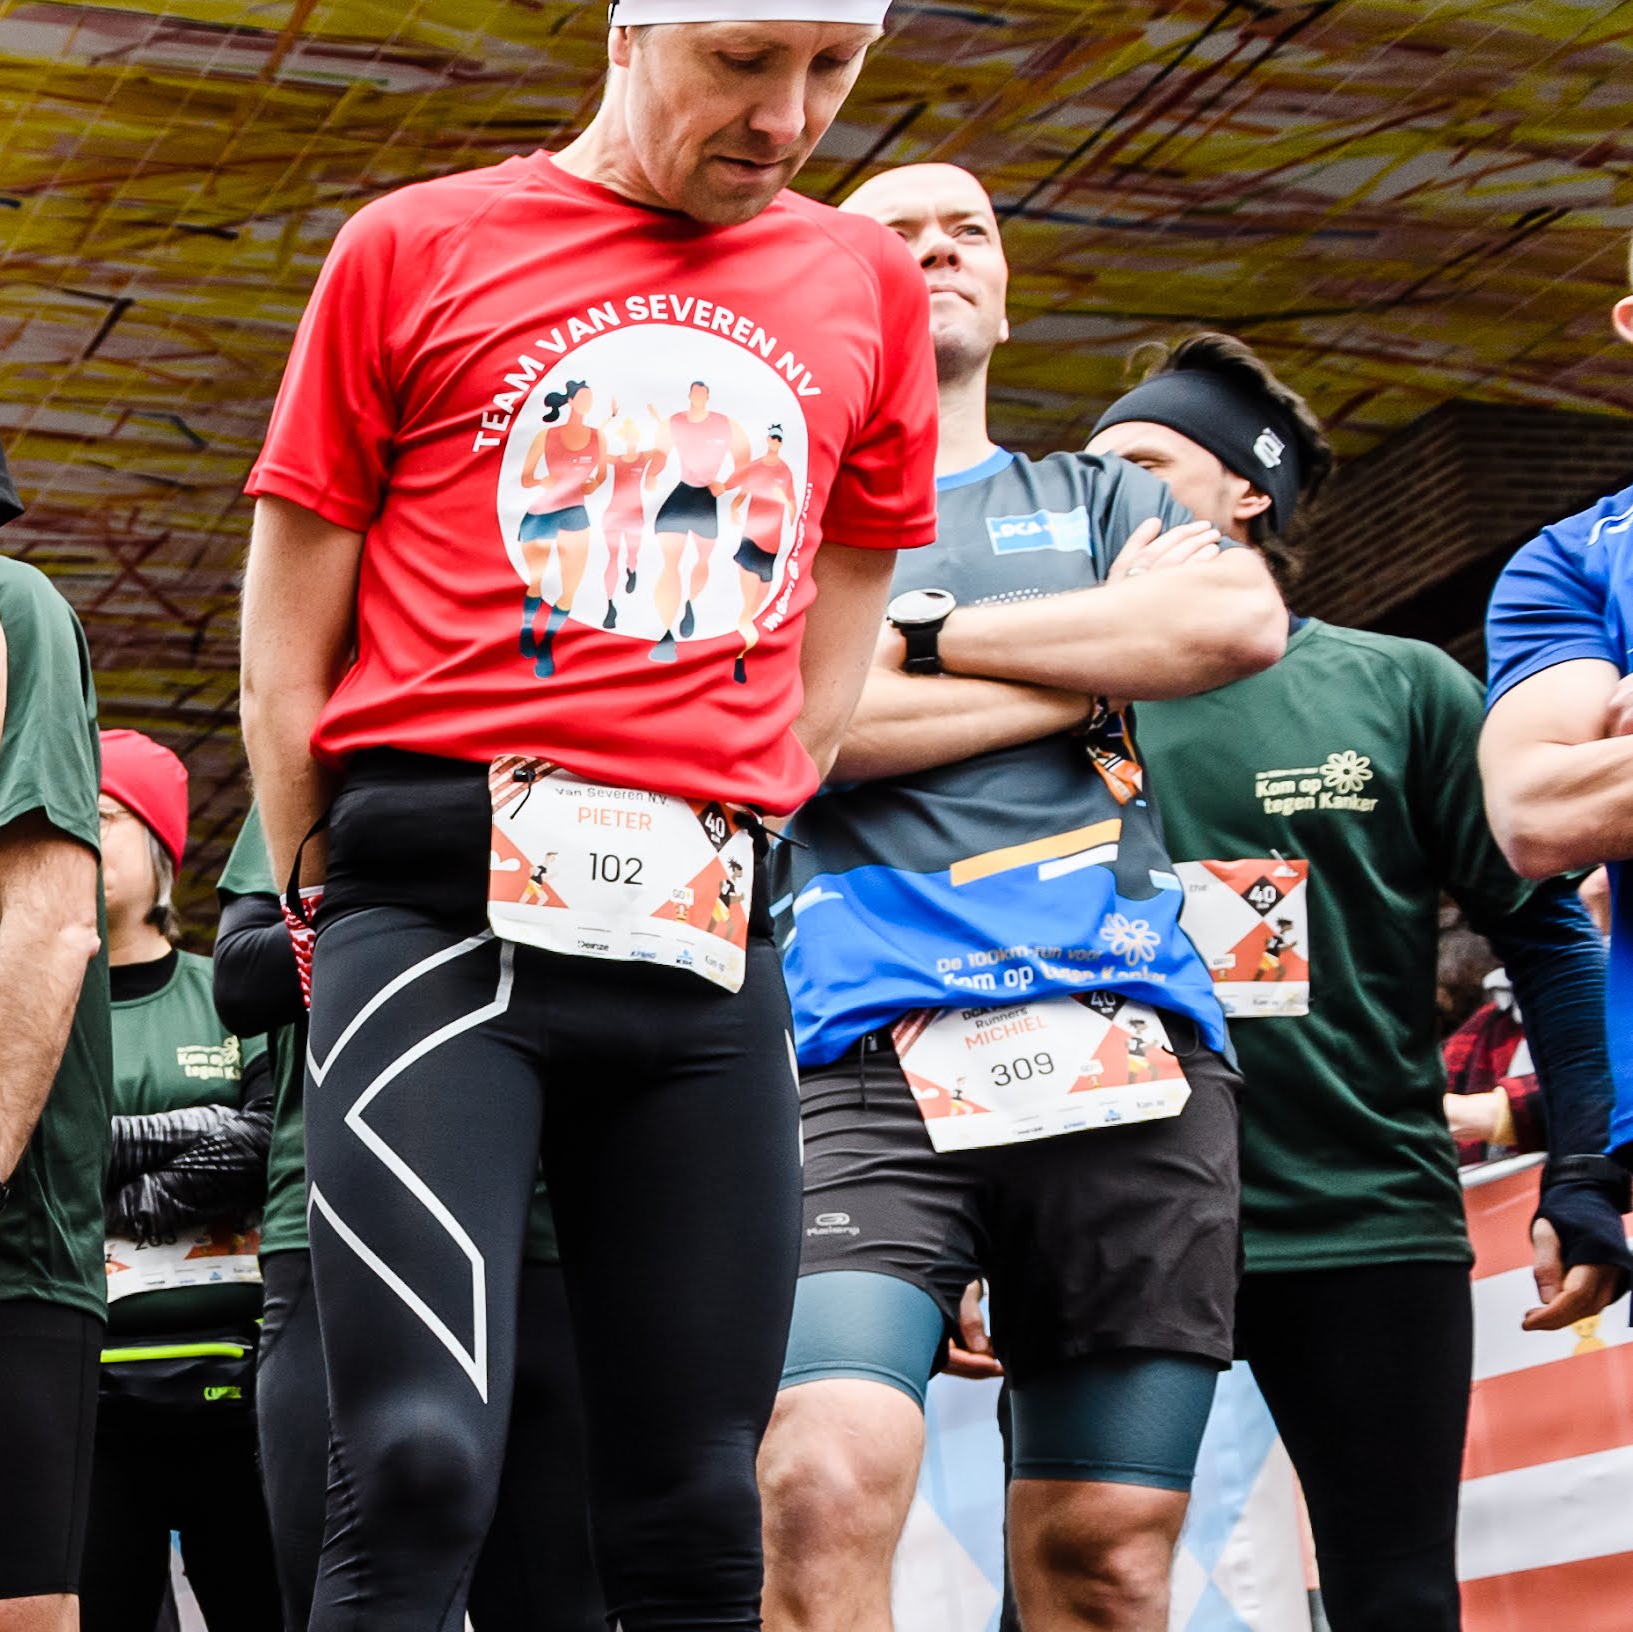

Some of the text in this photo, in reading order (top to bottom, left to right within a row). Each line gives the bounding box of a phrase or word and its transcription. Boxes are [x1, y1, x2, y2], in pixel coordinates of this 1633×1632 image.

[473, 294, 822, 454] TEAM VAN SEVEREN NV
[587, 787, 643, 801] Severen
[1255, 778, 1322, 798] Kom op
[1263, 791, 1379, 816] tegen Kanker
[577, 806, 652, 831] PIETER
[704, 812, 726, 835] 40
[590, 852, 644, 886] 102
[1247, 885, 1277, 903] 40
[937, 957, 963, 974] De
[1004, 966, 1034, 991] op
[975, 1006, 1028, 1029] Runners
[964, 1015, 1048, 1051] MICHIEL
[990, 1052, 1055, 1087] 309
